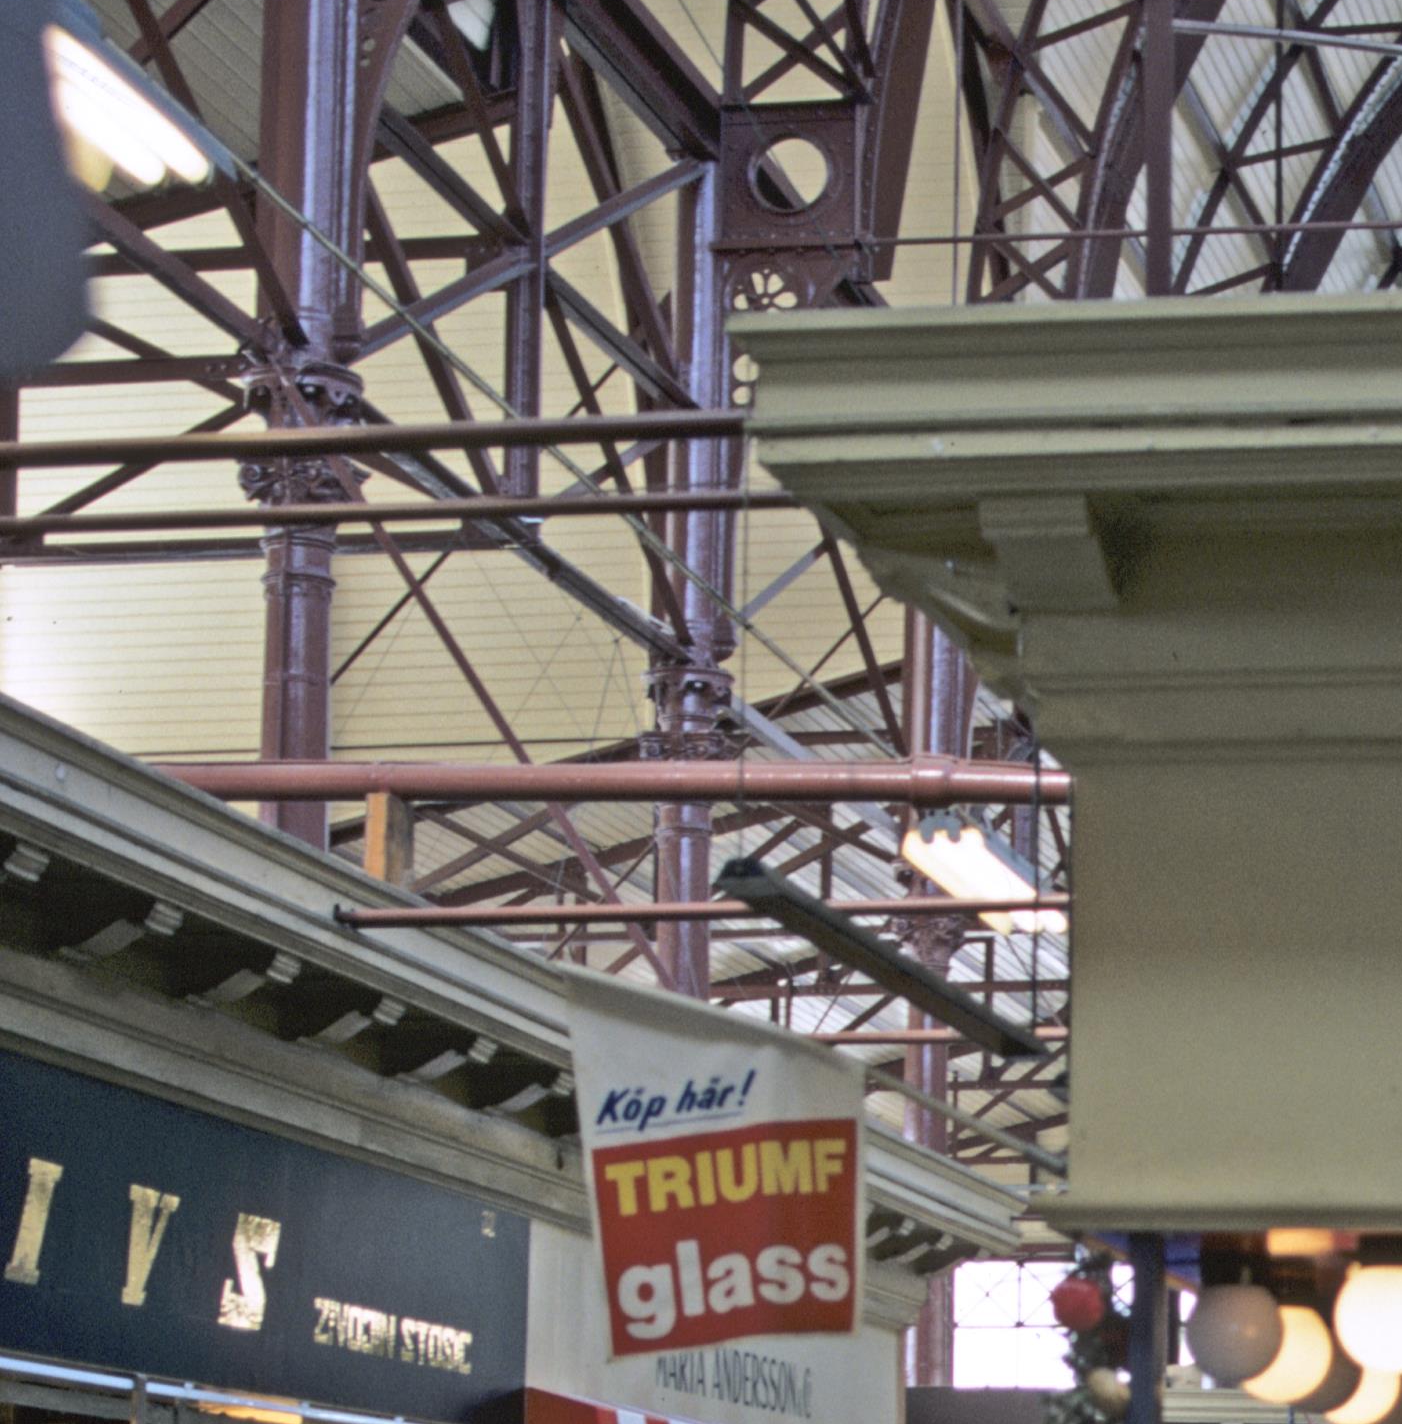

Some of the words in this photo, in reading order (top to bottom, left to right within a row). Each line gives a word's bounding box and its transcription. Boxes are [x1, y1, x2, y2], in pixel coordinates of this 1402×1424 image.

[597, 1086, 665, 1132] Köp
[676, 1069, 757, 1114] här!
[605, 1138, 847, 1217] TRIUMF
[617, 1239, 851, 1340] glass
